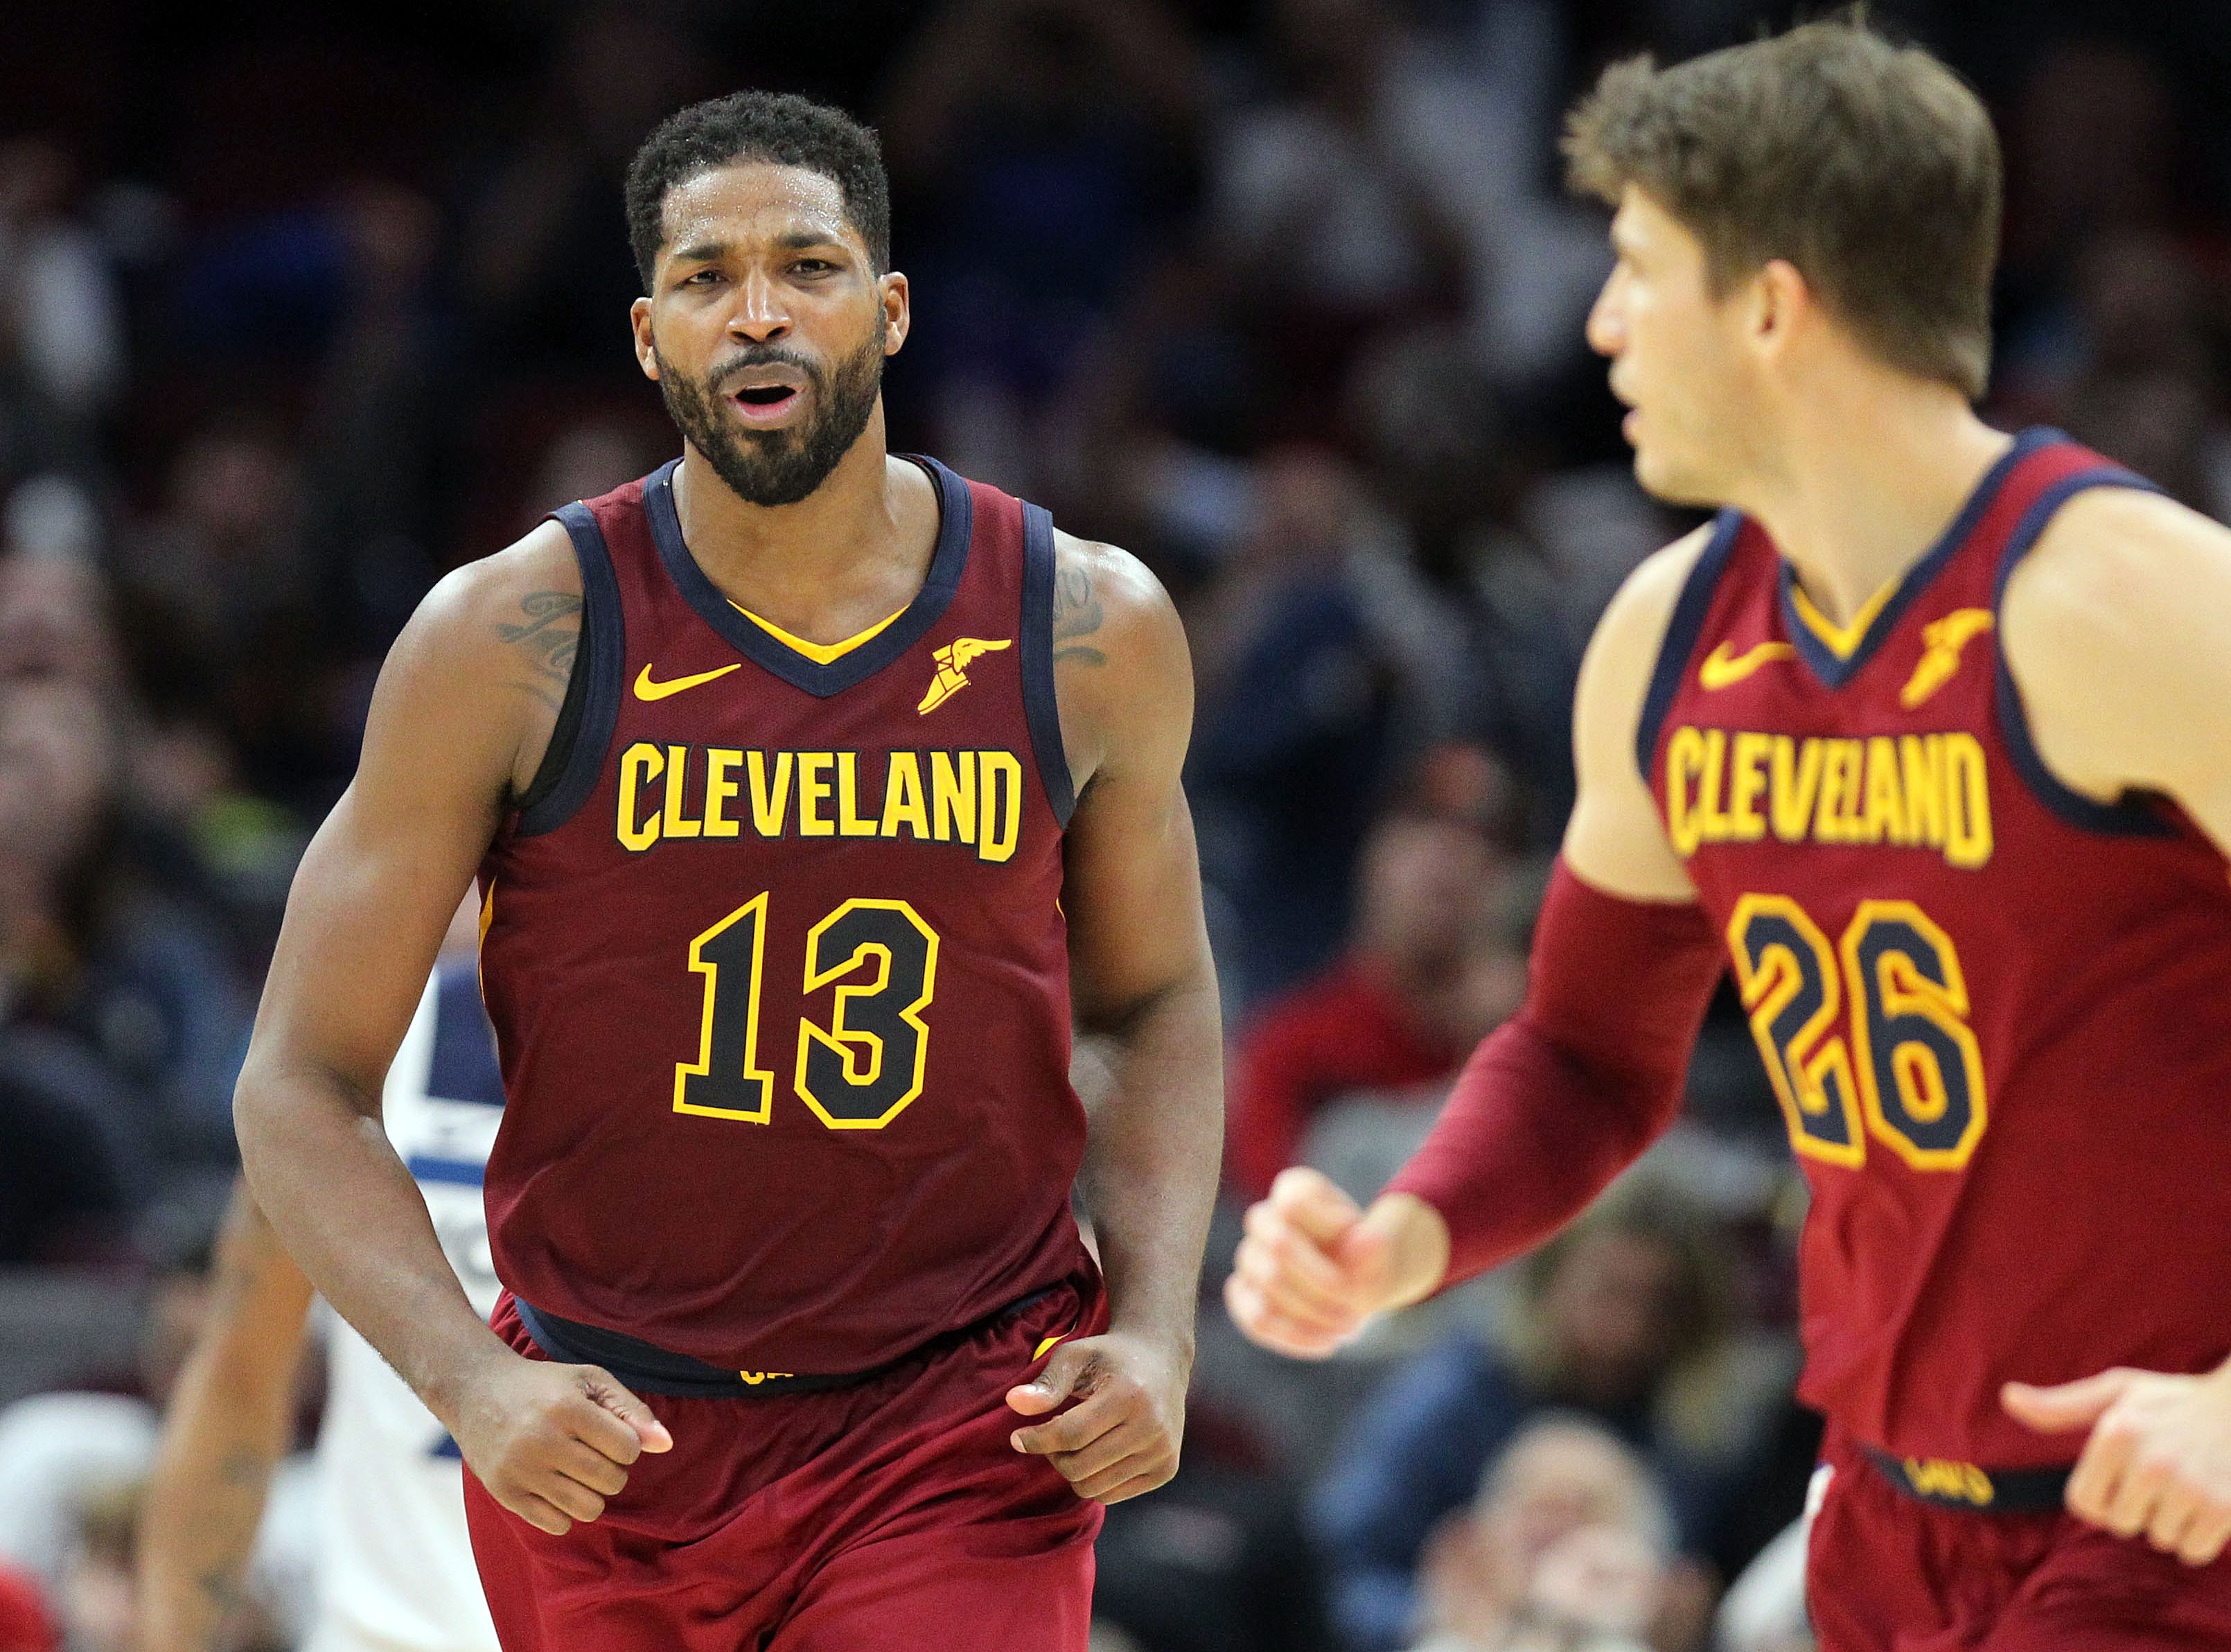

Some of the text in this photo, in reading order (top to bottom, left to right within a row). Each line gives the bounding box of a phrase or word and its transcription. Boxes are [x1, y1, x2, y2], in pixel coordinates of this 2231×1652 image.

[615, 741, 1023, 863] CLEVELAND
[1667, 726, 1994, 869] CLEVELAND
[672, 890, 940, 1130] 13
[1727, 892, 1988, 1172] 26
